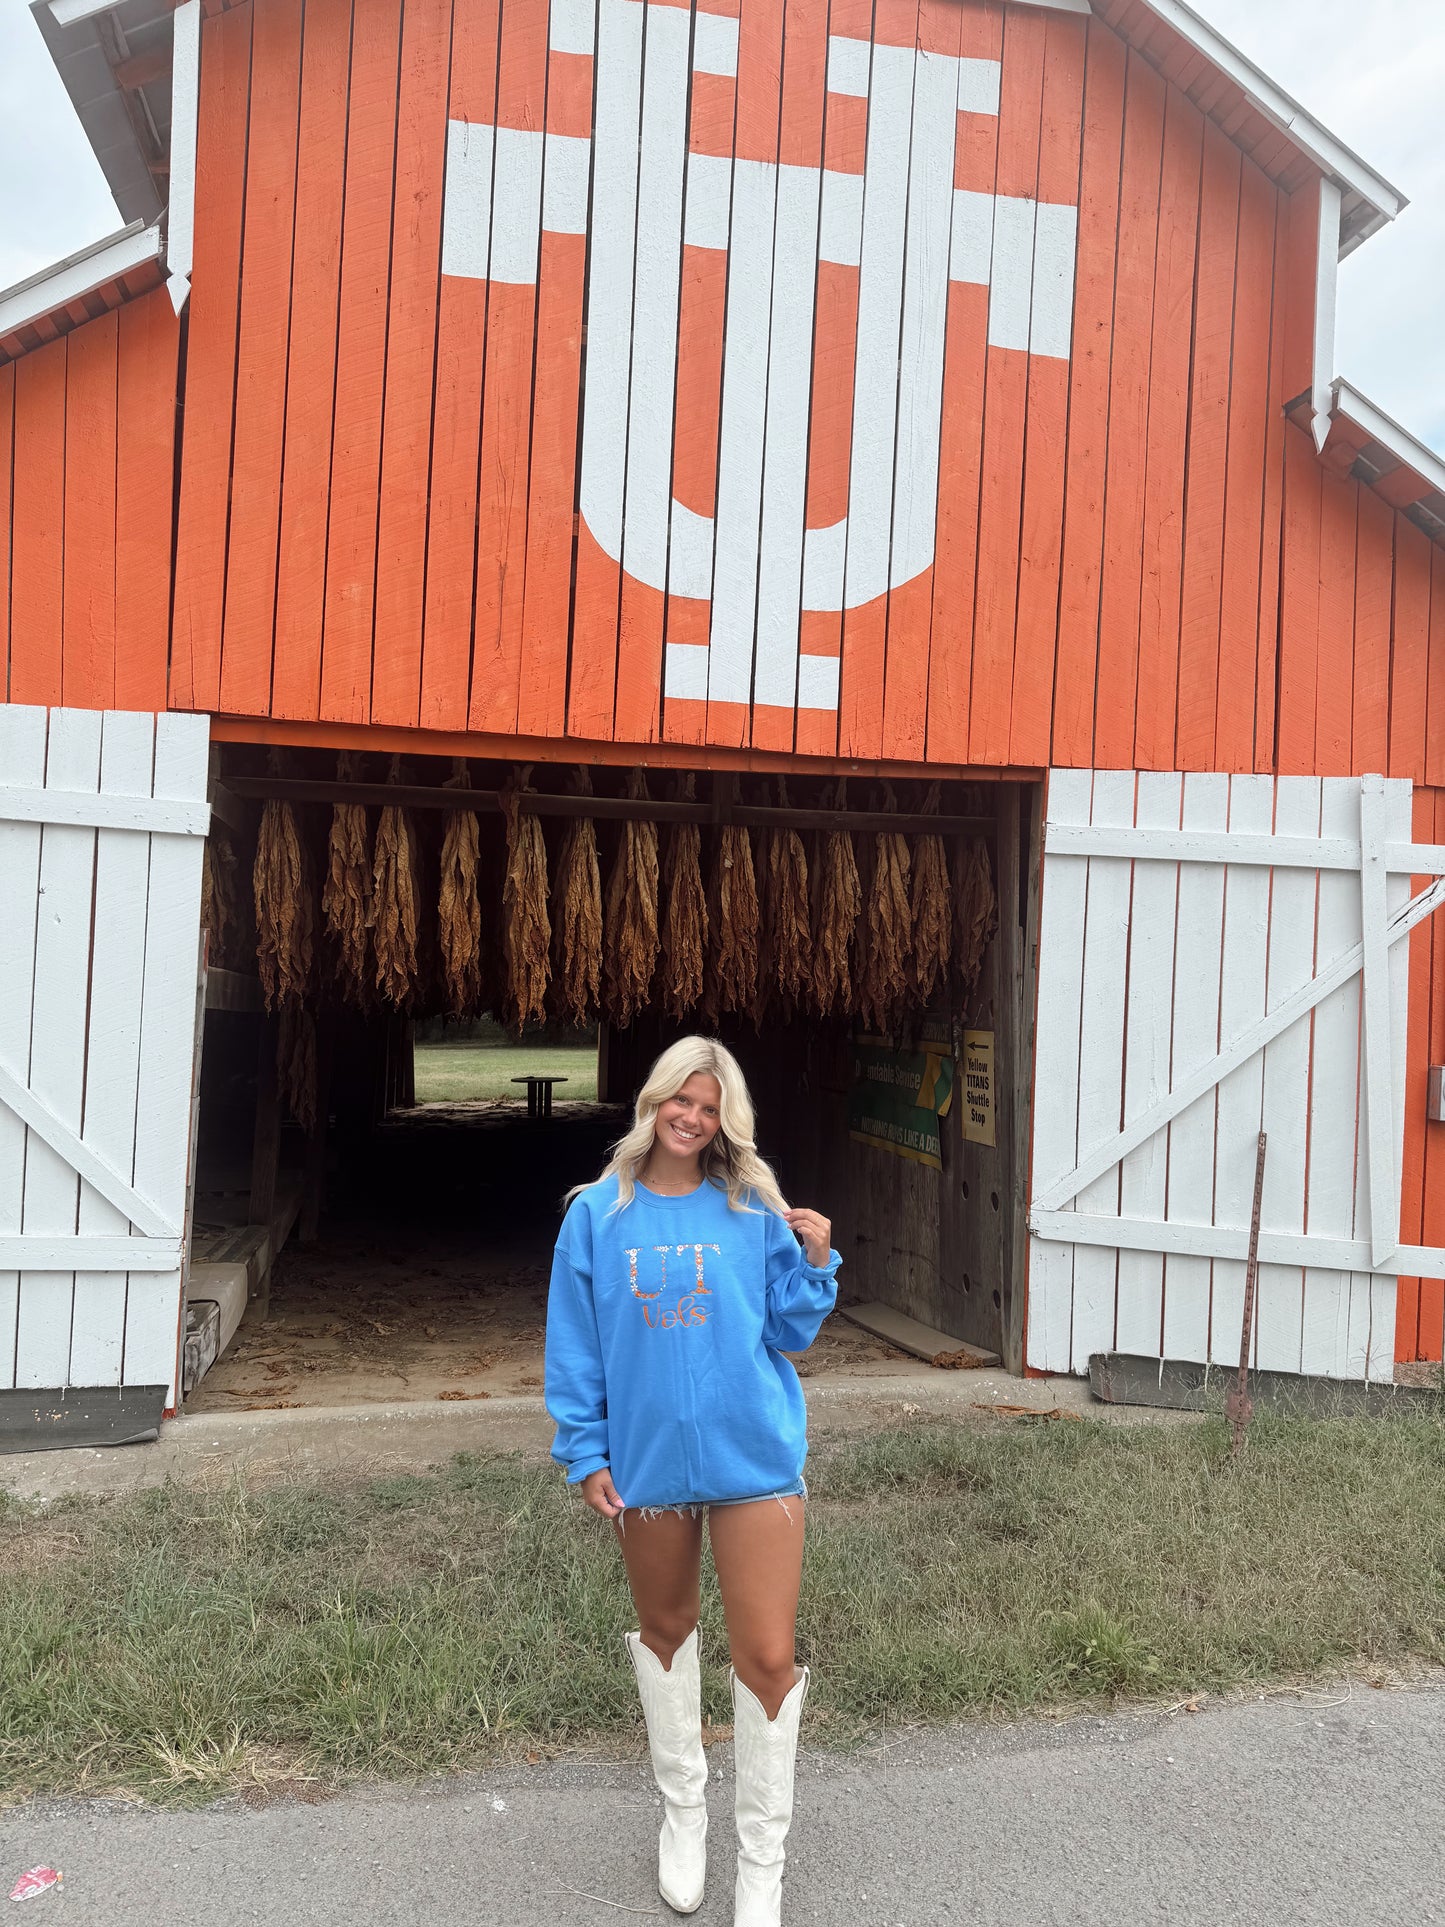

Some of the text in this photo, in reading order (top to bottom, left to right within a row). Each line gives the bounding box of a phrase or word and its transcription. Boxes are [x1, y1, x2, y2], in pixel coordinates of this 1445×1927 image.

[855, 1059, 921, 1090] Dndable Service
[967, 1057, 988, 1073] Yellow
[966, 1074, 989, 1090] TITANS
[966, 1090, 990, 1108] Shuttle
[971, 1108, 986, 1127] Stop
[861, 1115, 888, 1137] NOTHING
[904, 1128, 919, 1148] LIKE
[918, 1133, 925, 1151] A
[624, 1243, 721, 1300] UT
[642, 1295, 714, 1329] Vols
